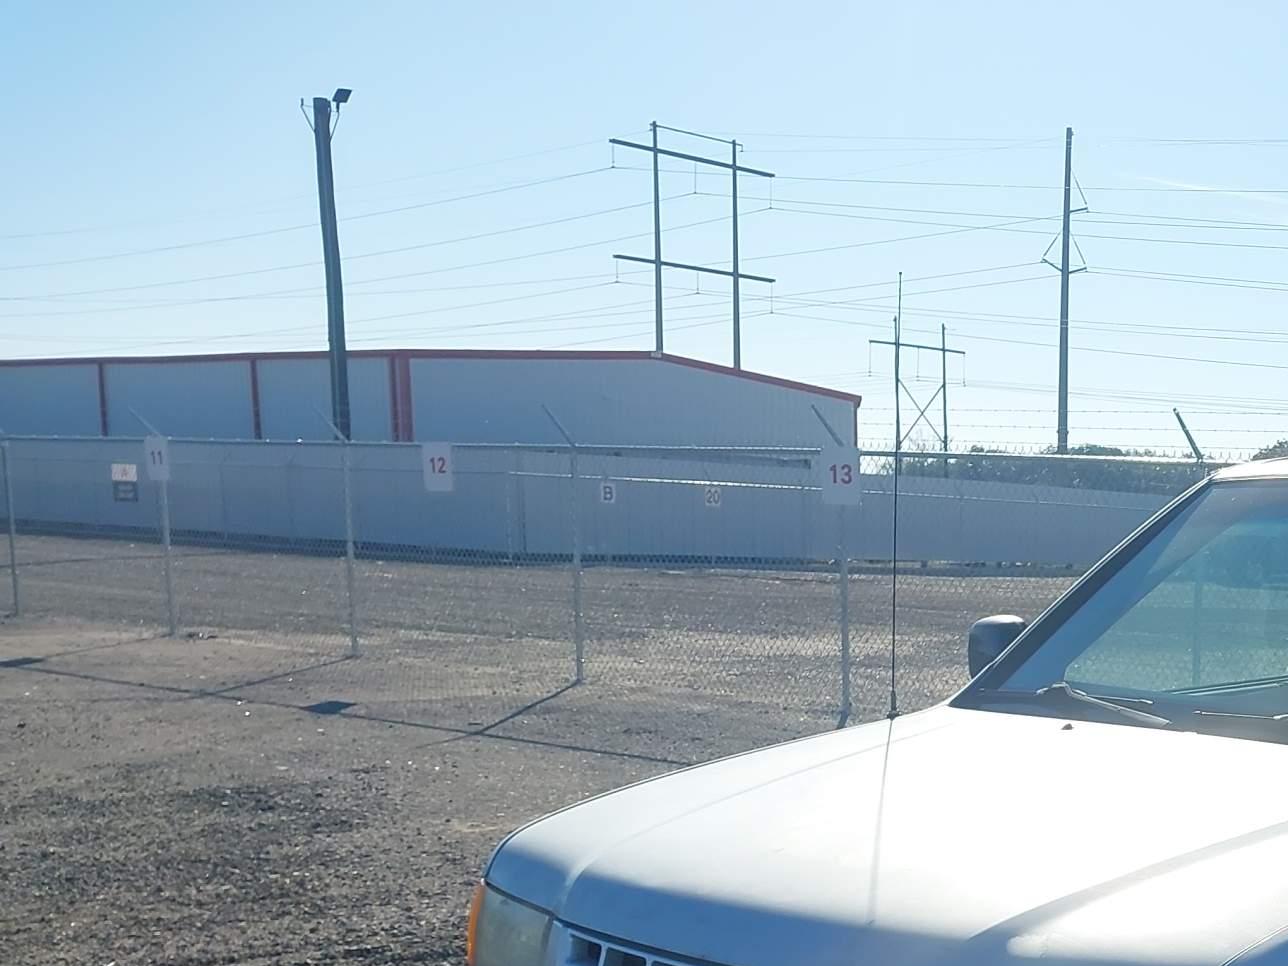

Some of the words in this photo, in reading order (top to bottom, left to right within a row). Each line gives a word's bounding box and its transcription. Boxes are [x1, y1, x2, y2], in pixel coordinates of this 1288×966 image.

[150, 449, 163, 465] 11
[429, 456, 447, 474] 12
[829, 463, 853, 485] 13
[602, 485, 614, 501] B
[705, 488, 720, 505] 20
